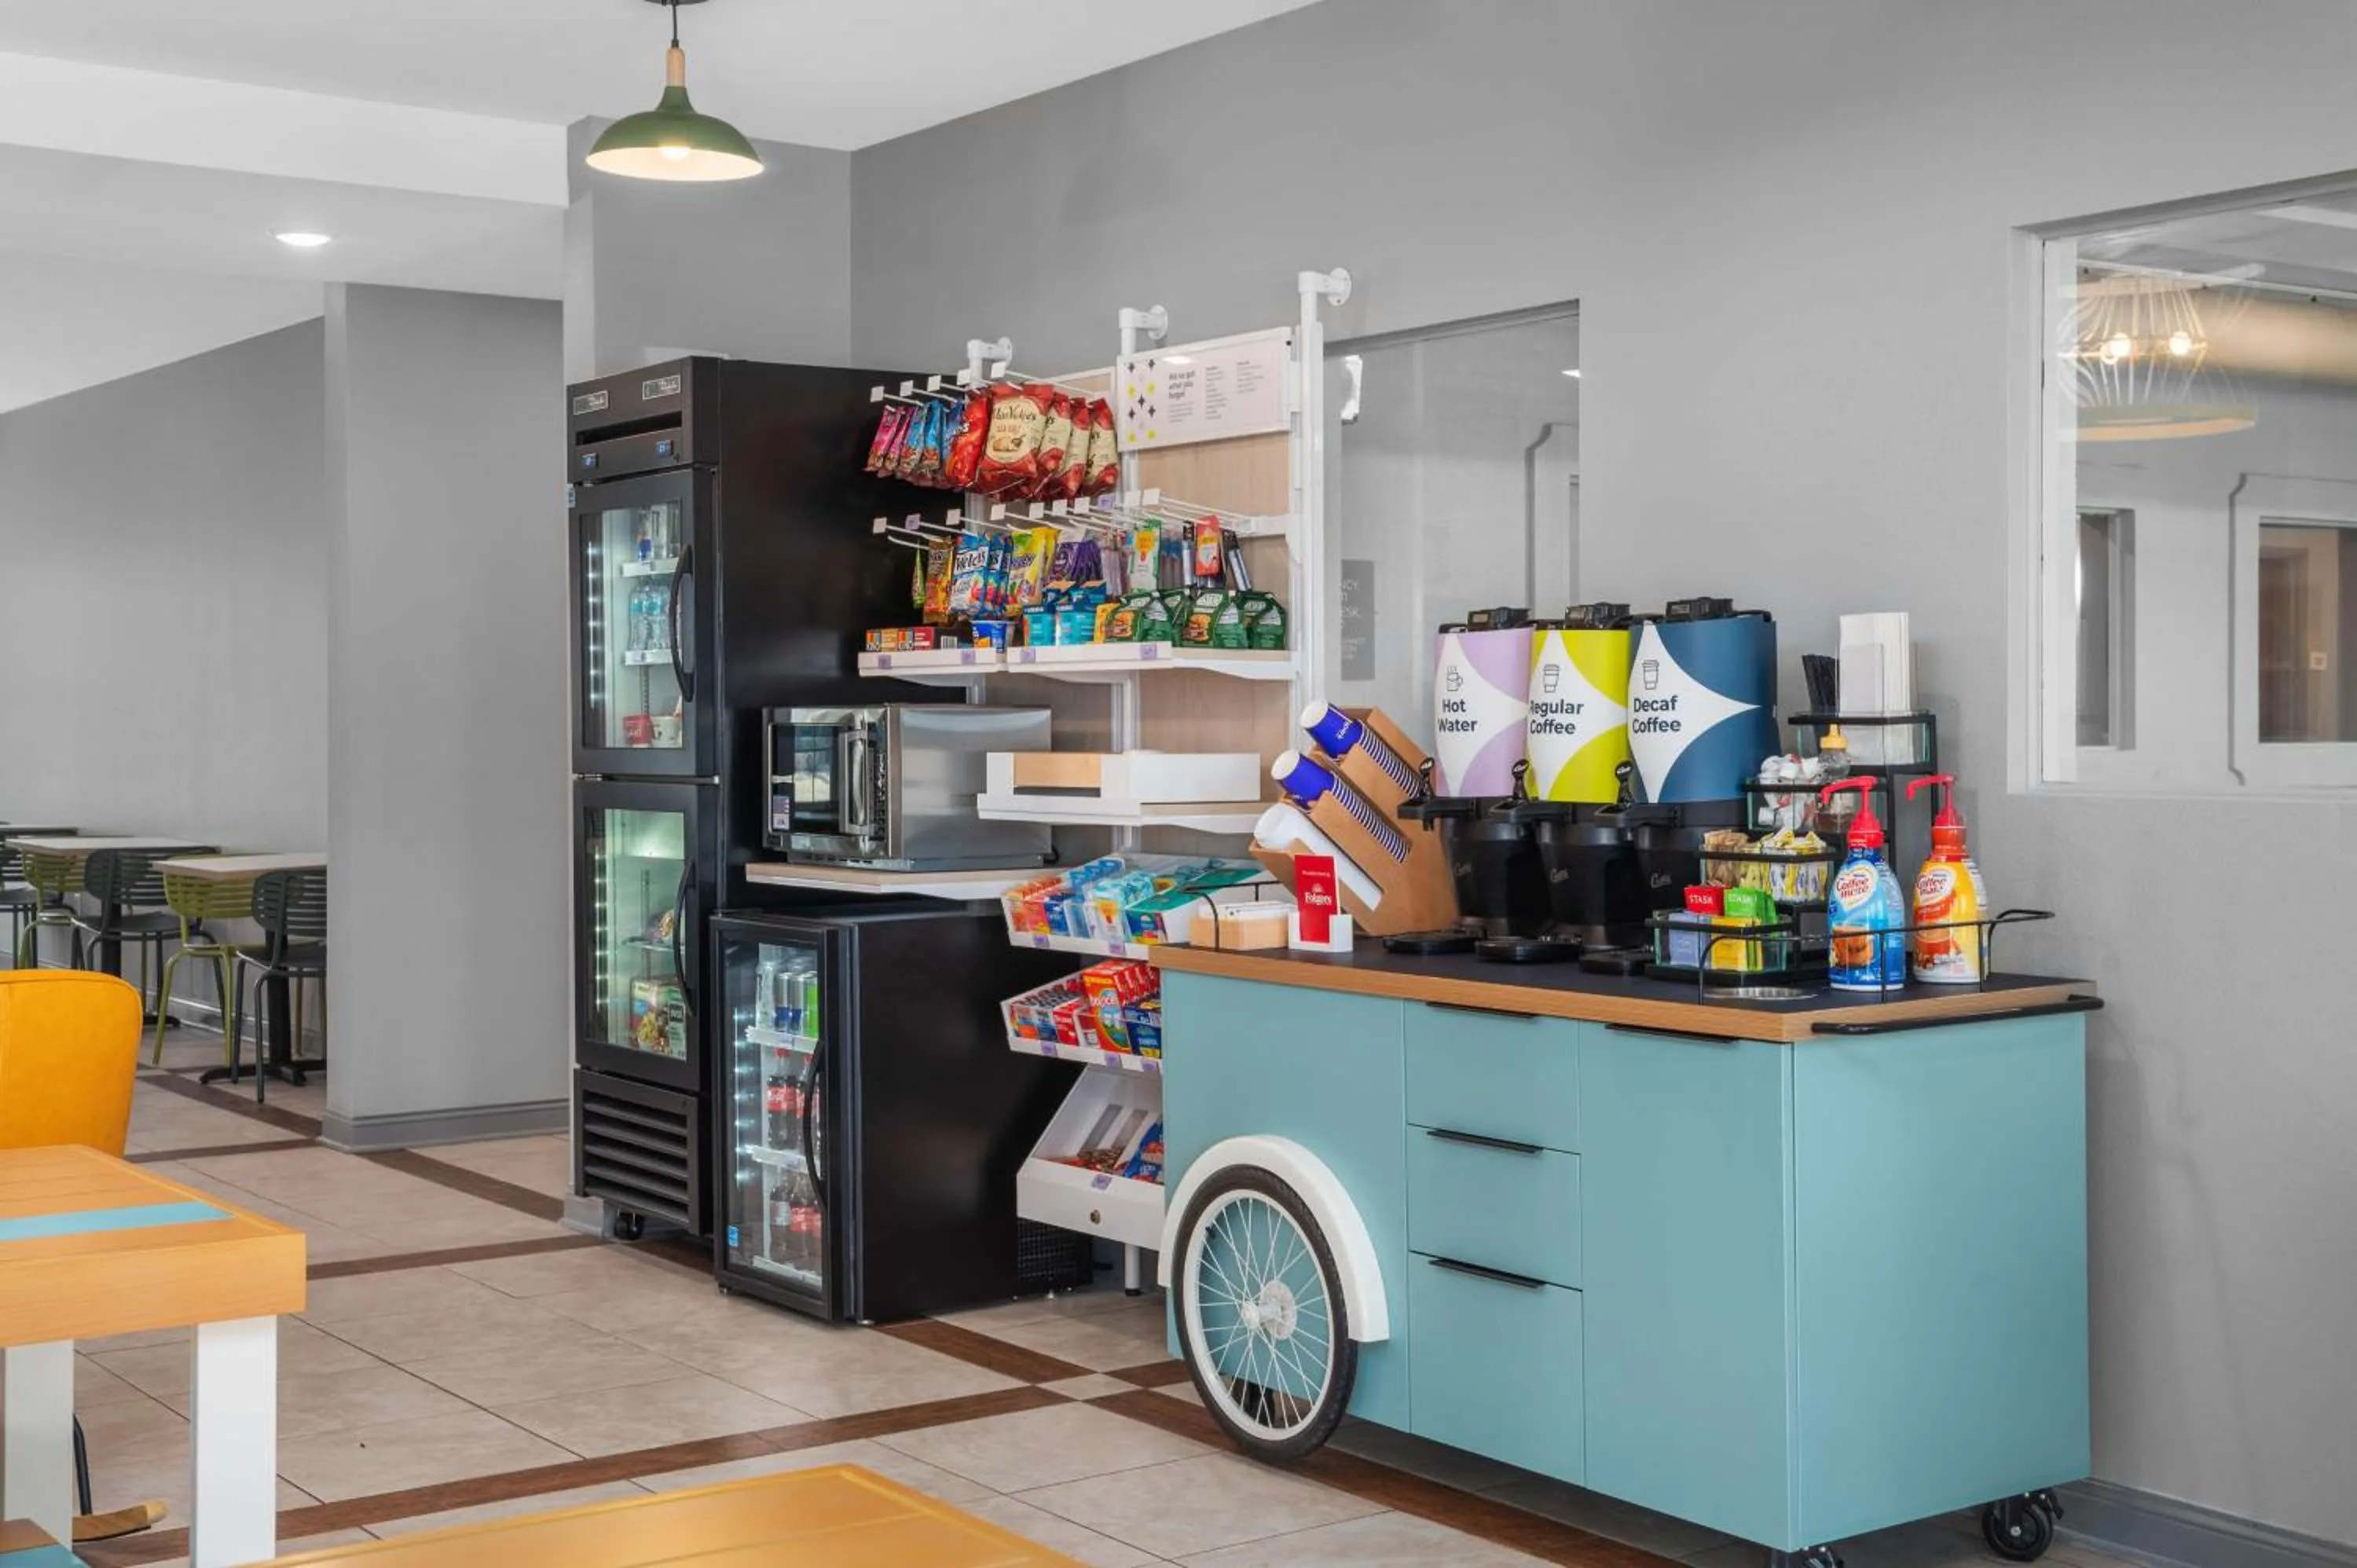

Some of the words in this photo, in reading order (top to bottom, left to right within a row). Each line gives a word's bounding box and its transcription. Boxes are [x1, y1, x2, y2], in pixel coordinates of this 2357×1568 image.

[1442, 698, 1466, 713] Hot
[1633, 695, 1678, 712] Decaf
[1438, 718, 1477, 733] Water
[1530, 718, 1576, 735] Coffee
[1632, 716, 1682, 733] Coffee
